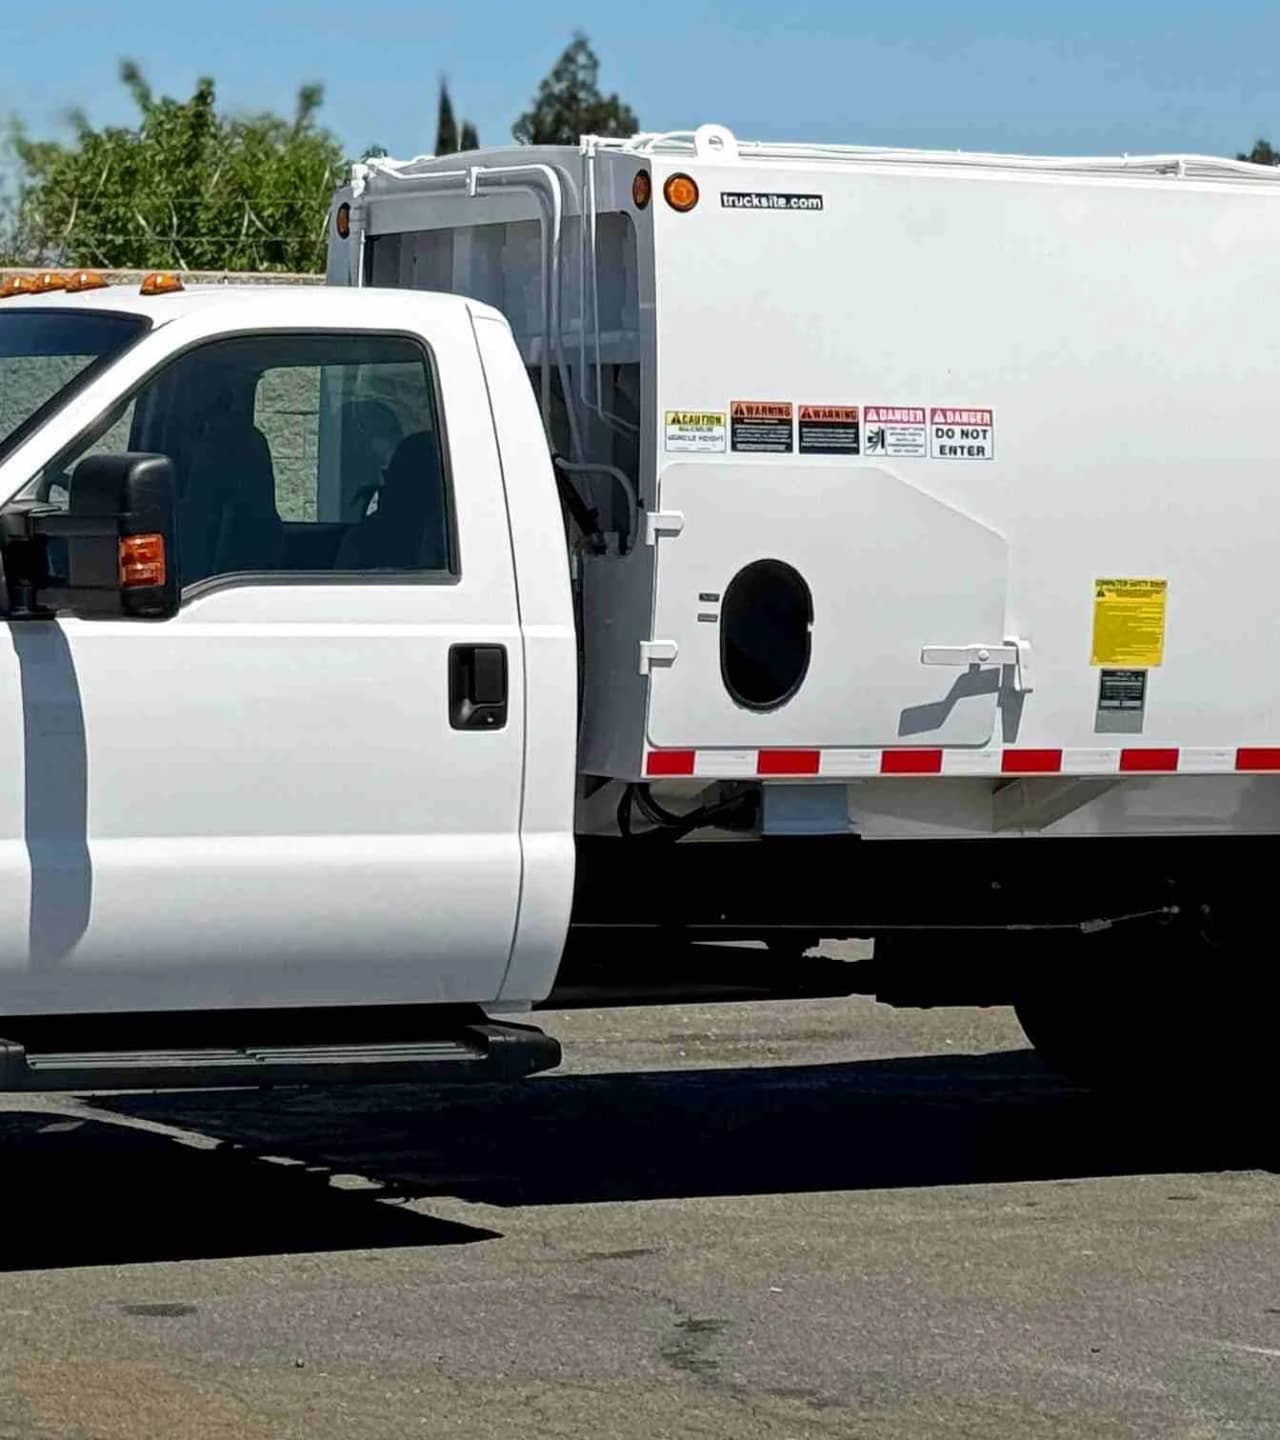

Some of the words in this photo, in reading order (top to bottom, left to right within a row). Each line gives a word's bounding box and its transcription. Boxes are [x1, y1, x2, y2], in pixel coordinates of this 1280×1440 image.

[723, 194, 821, 209] trucksite.com
[746, 405, 791, 417] WARNING
[880, 408, 924, 422] DANGER
[682, 414, 721, 426] CAUTION
[945, 410, 990, 425] DANGER
[935, 428, 955, 439] DO
[960, 428, 988, 440] NOT
[939, 445, 985, 456] ENTER
